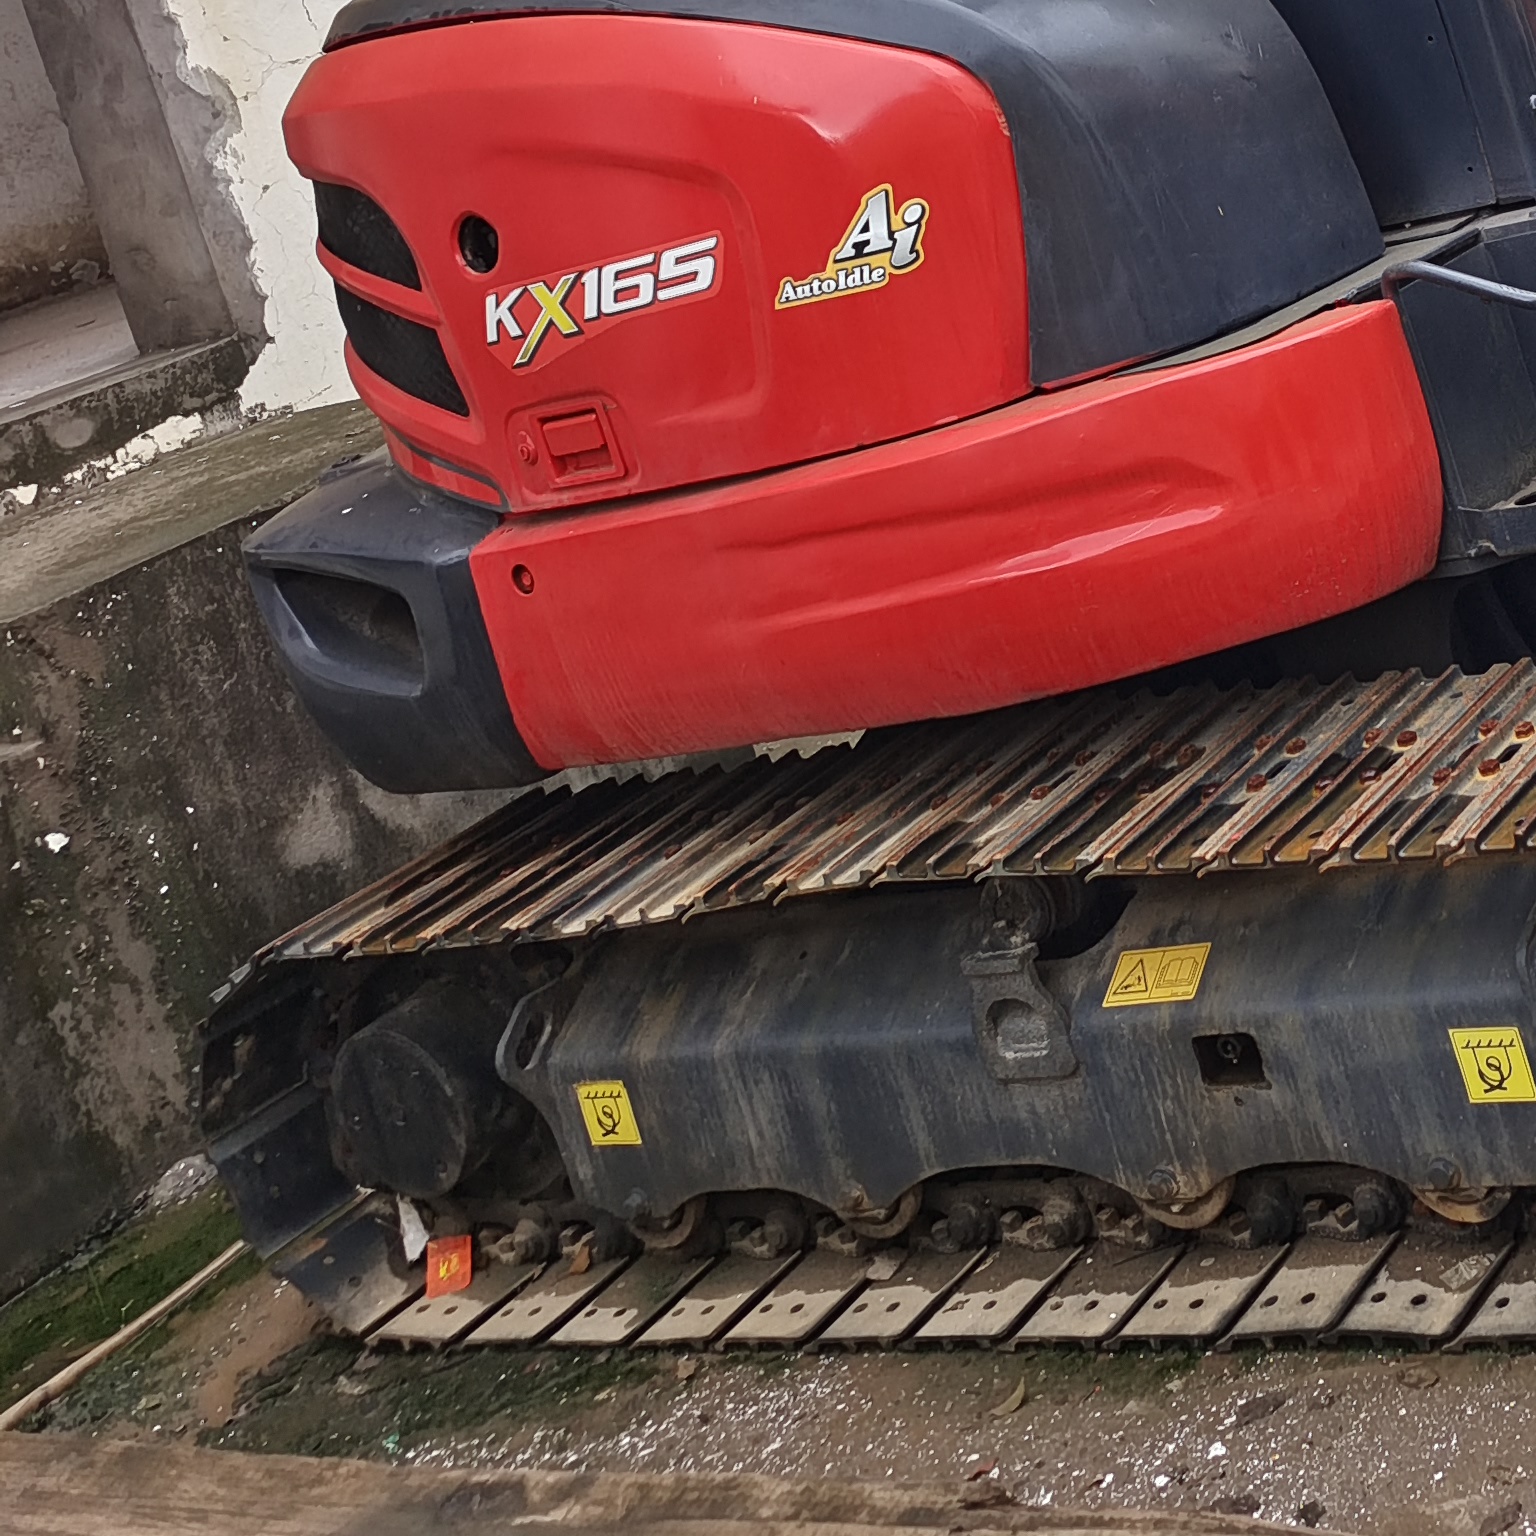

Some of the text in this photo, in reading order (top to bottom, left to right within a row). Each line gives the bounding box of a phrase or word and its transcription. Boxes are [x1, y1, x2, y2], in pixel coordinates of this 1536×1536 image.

[834, 190, 925, 269] Ai
[484, 235, 719, 369] KX165
[779, 264, 886, 303] AutoIdle
